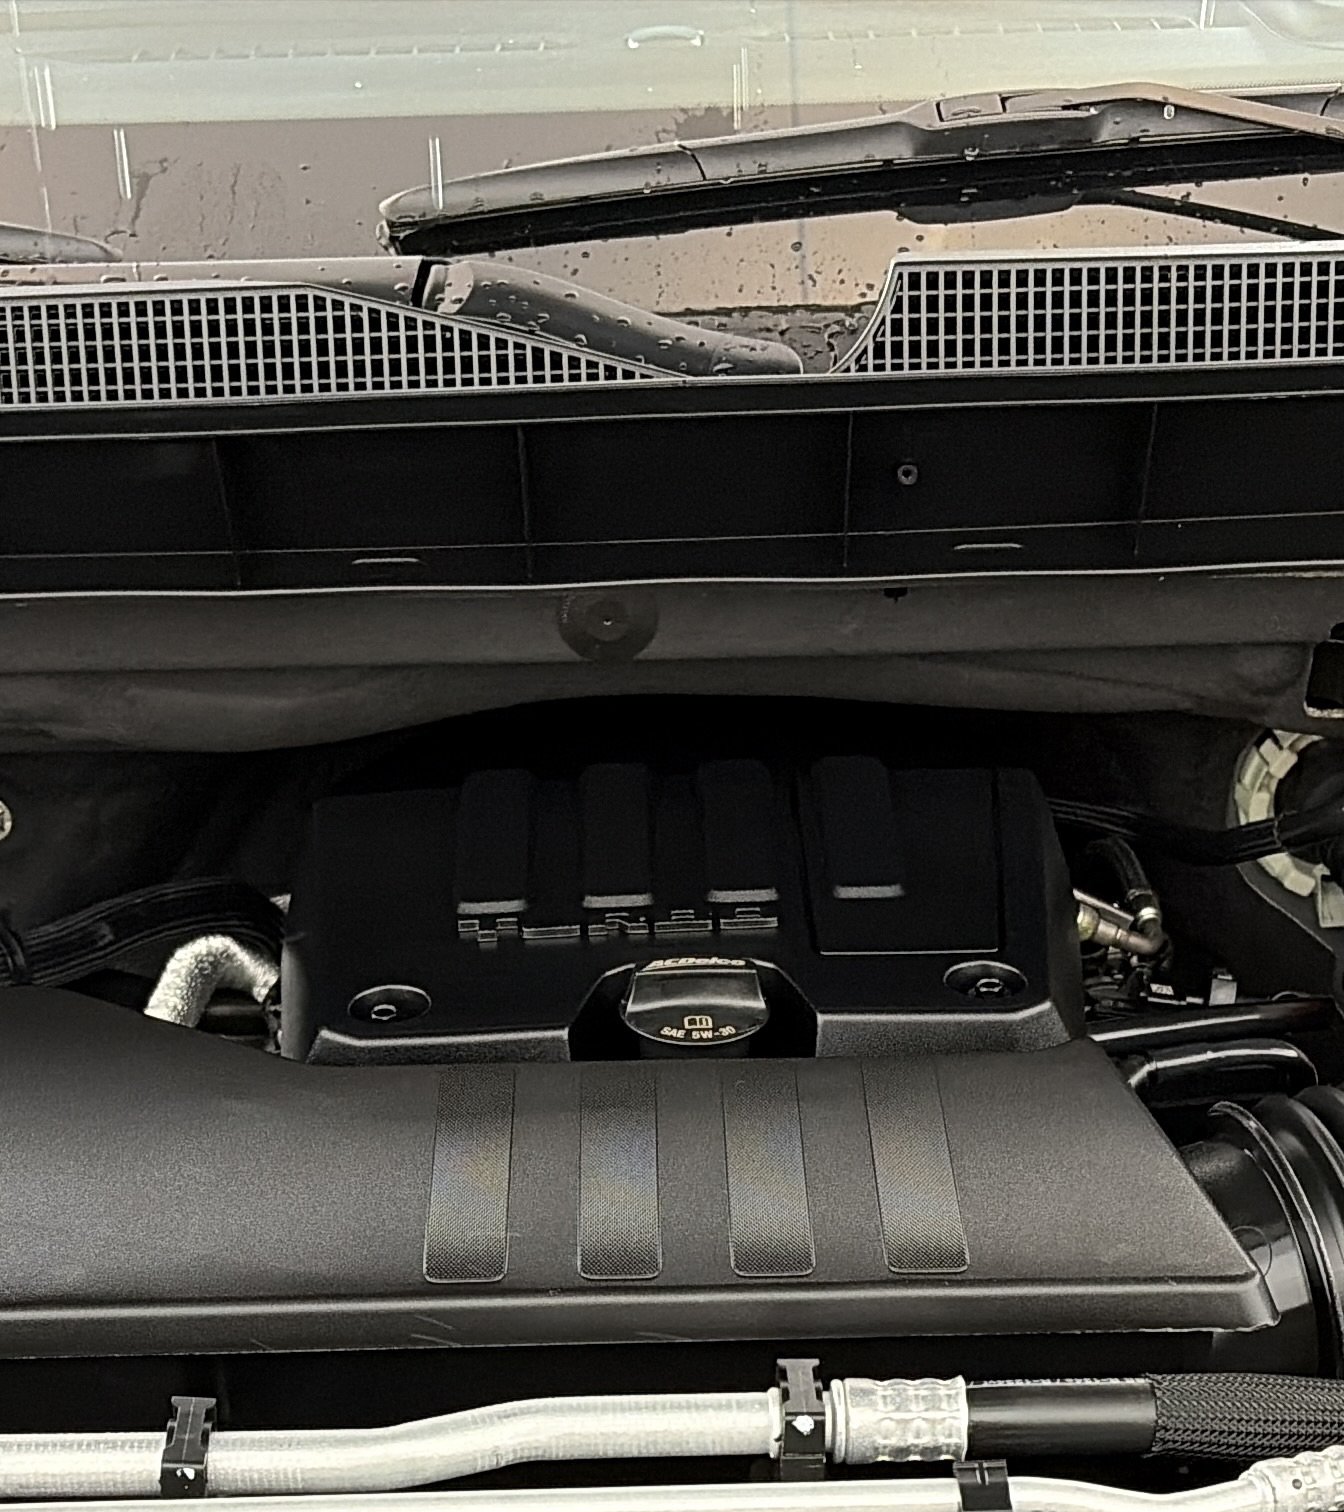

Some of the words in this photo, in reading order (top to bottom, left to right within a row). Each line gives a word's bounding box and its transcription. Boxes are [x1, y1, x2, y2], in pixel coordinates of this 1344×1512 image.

[642, 957, 746, 971] ACDelco
[660, 1026, 687, 1039] SAE
[691, 1025, 737, 1039] 5W-30
